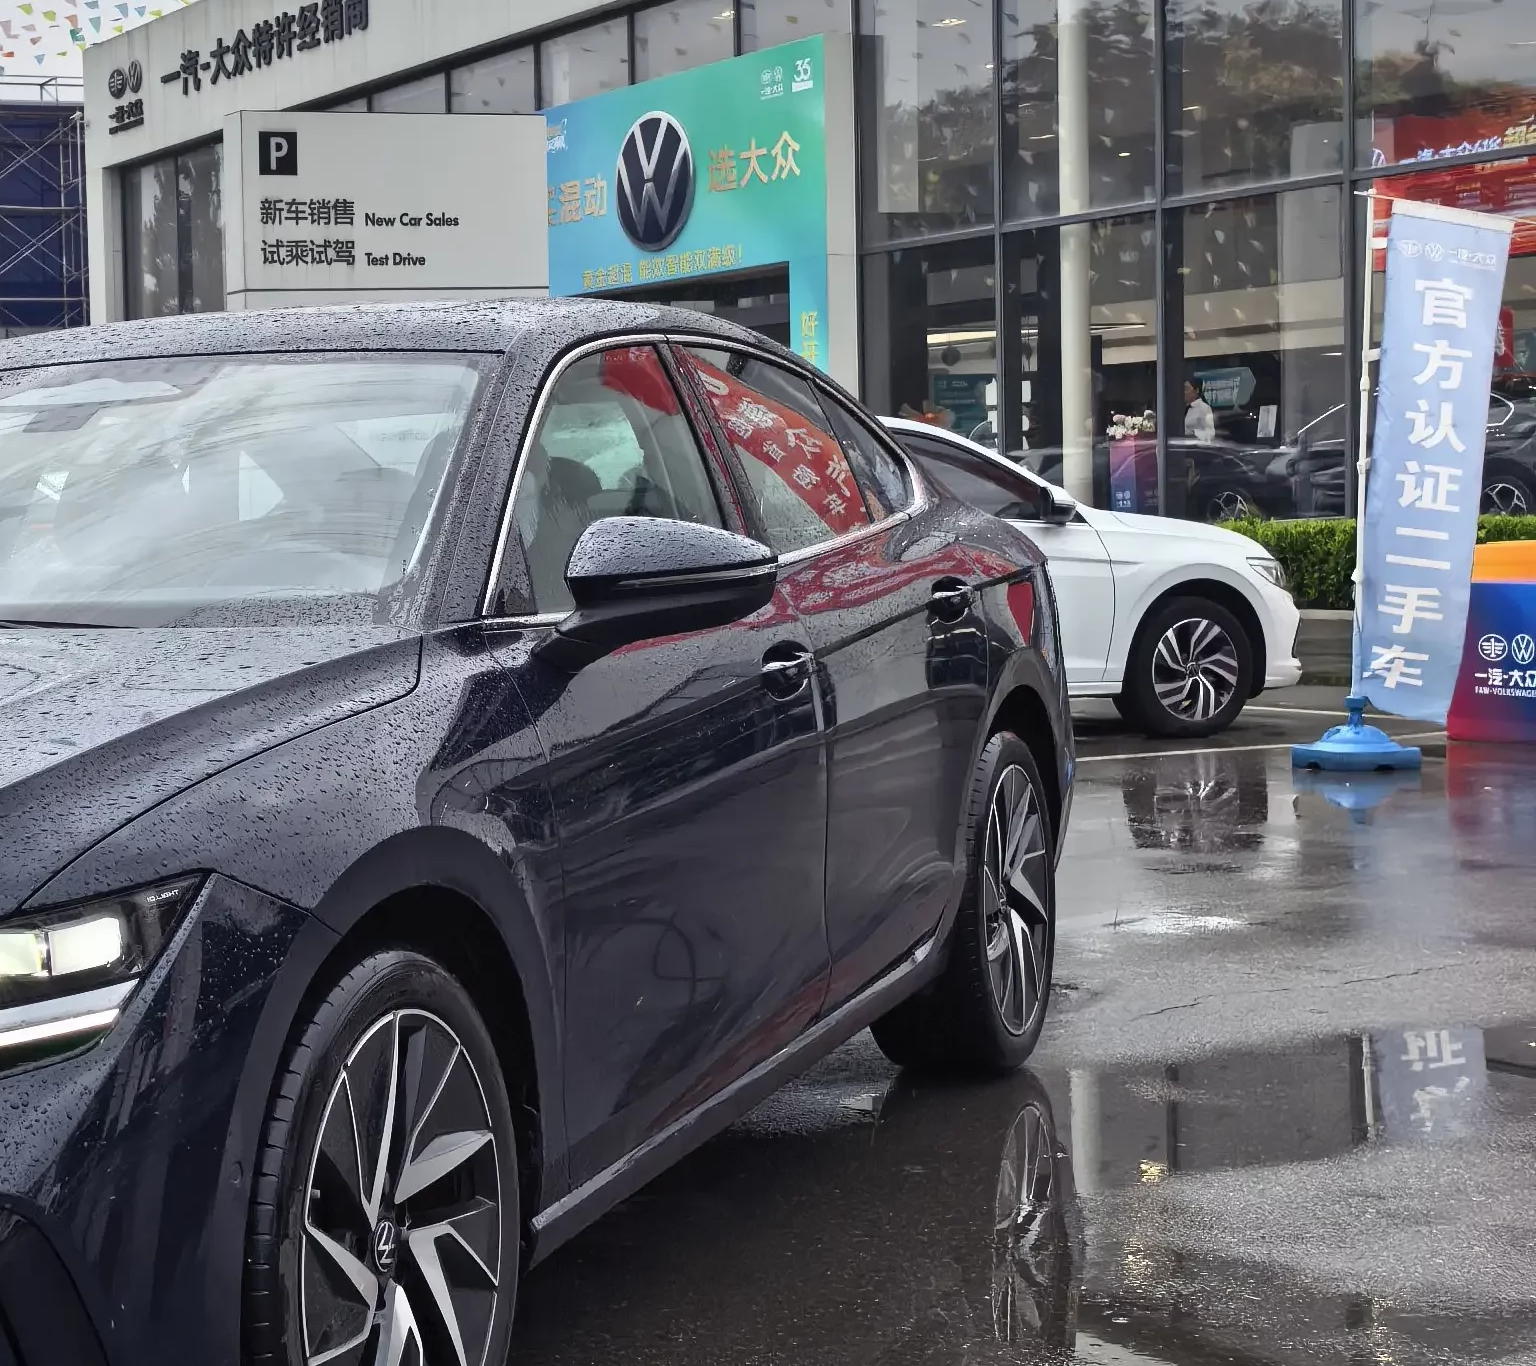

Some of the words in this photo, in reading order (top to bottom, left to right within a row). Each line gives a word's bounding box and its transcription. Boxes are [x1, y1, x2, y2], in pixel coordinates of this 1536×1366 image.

[269, 136, 289, 171] P
[260, 197, 356, 226] 新车销售
[364, 212, 396, 227] New
[399, 212, 423, 227] Car
[425, 211, 460, 227] Sales
[261, 239, 356, 267] 试乘试驾
[364, 252, 390, 267] Test
[392, 252, 427, 267] Drive
[1362, 277, 1475, 690] 官方认证二手车
